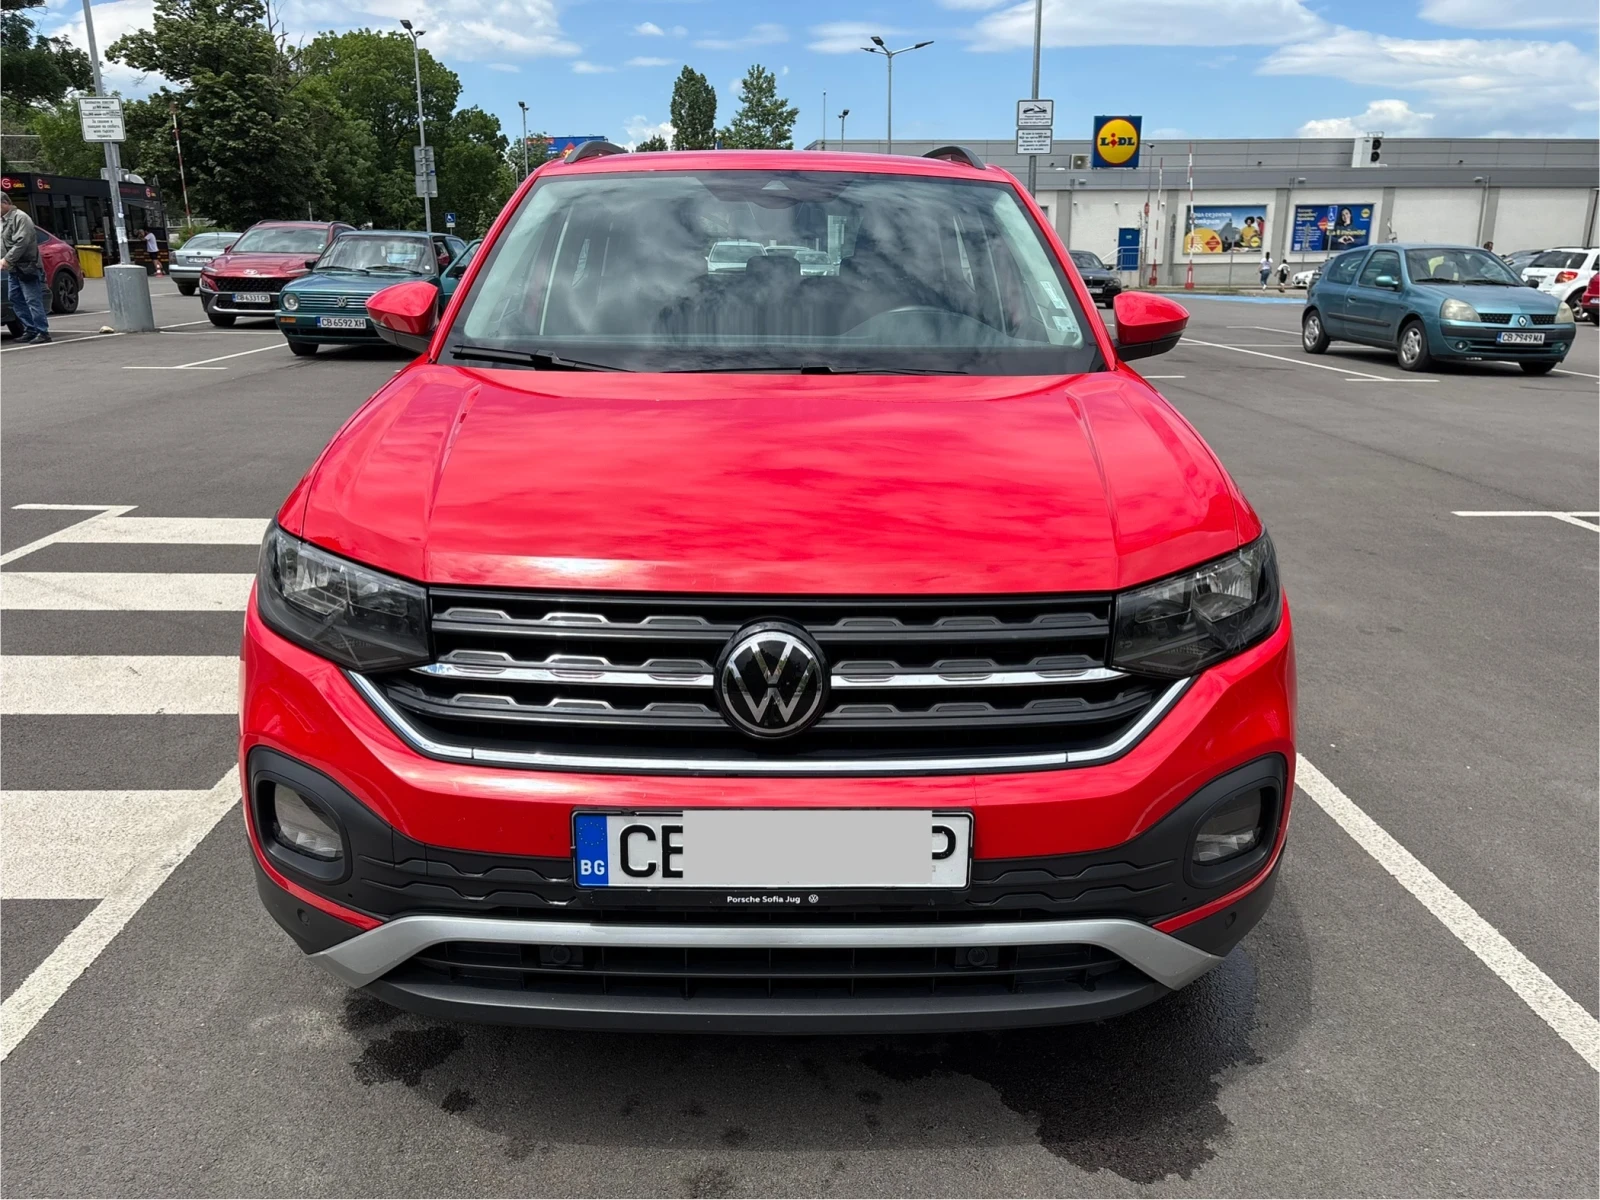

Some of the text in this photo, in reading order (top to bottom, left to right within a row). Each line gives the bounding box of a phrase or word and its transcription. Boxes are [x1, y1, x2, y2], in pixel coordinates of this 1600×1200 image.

[321, 318, 365, 327] CB 6592 XH
[581, 860, 605, 875] BG
[727, 895, 760, 903] Porsche
[762, 895, 784, 903] Sofia
[785, 895, 800, 904] Jug
